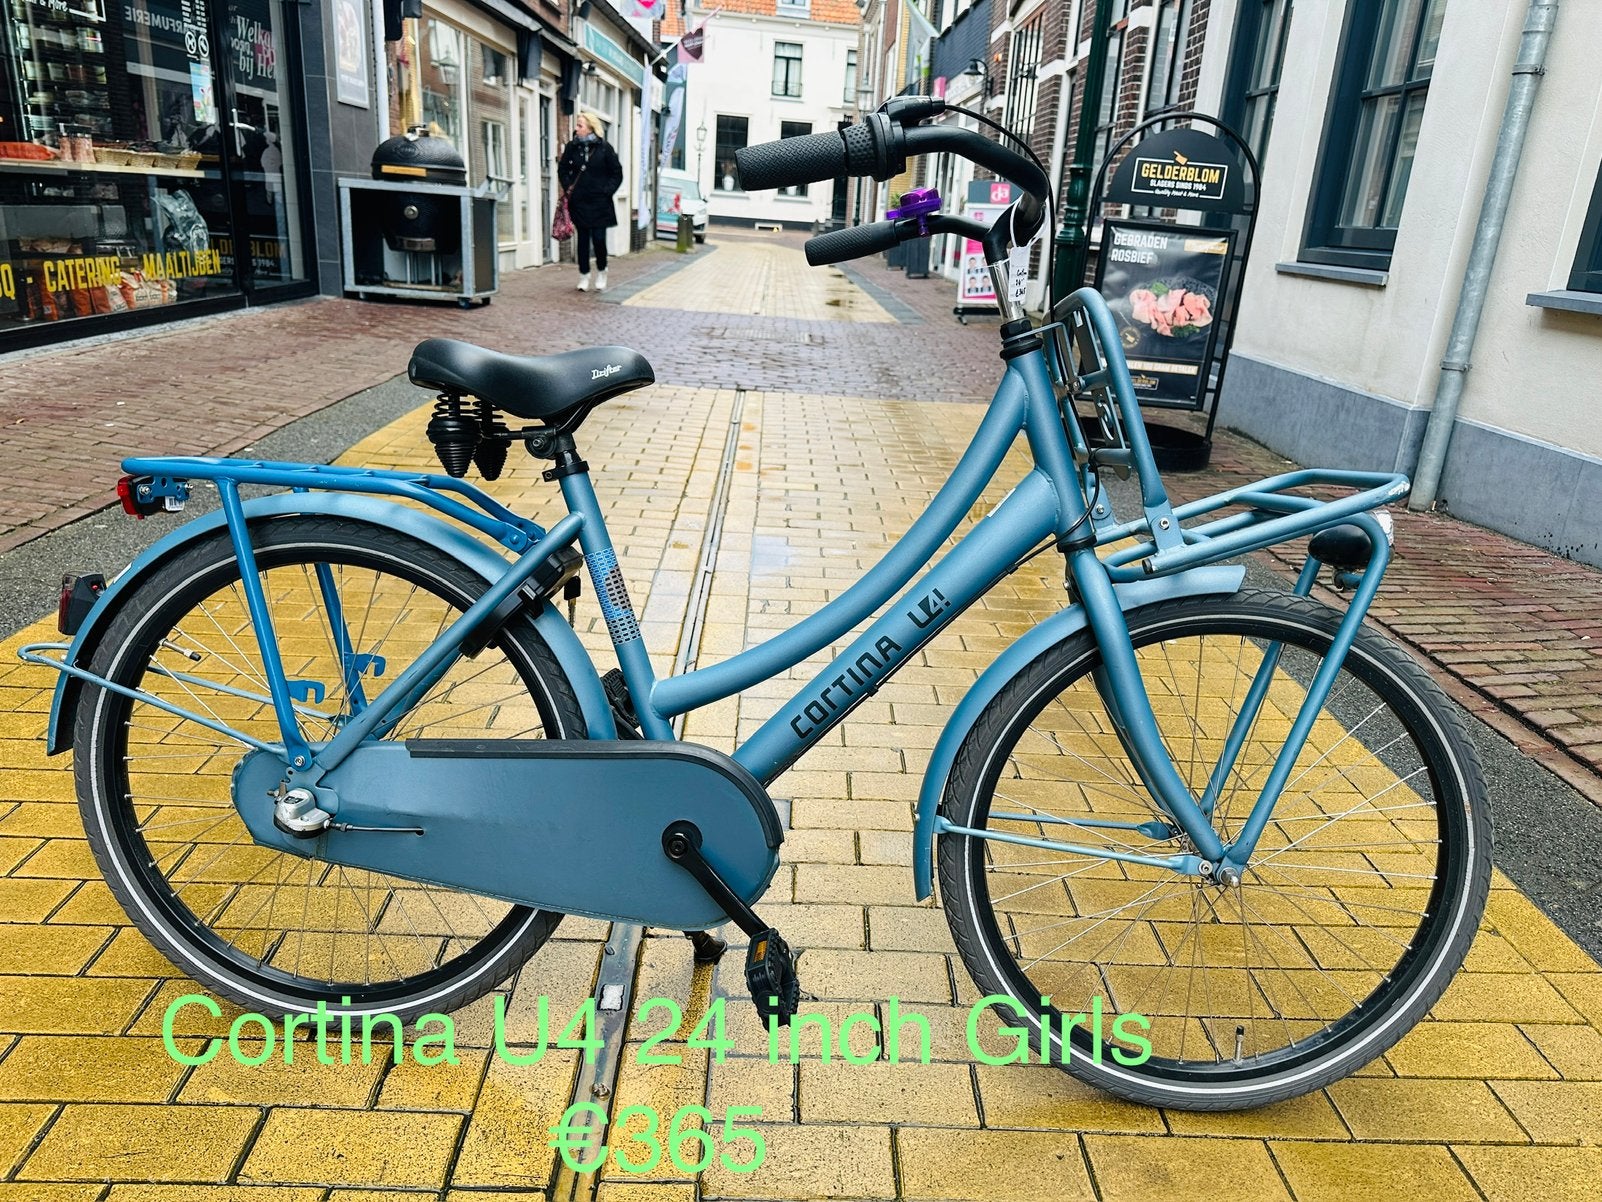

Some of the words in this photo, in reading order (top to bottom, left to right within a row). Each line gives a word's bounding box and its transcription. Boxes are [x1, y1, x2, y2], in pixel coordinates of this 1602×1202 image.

[1141, 163, 1220, 184] GELDERBLOM
[1114, 232, 1168, 250] GEBRADEN
[1111, 249, 1154, 264] ROSBIEF
[43, 256, 121, 293] CATERING
[143, 249, 221, 282] MAALTIJDEN
[591, 364, 622, 380] Drifter
